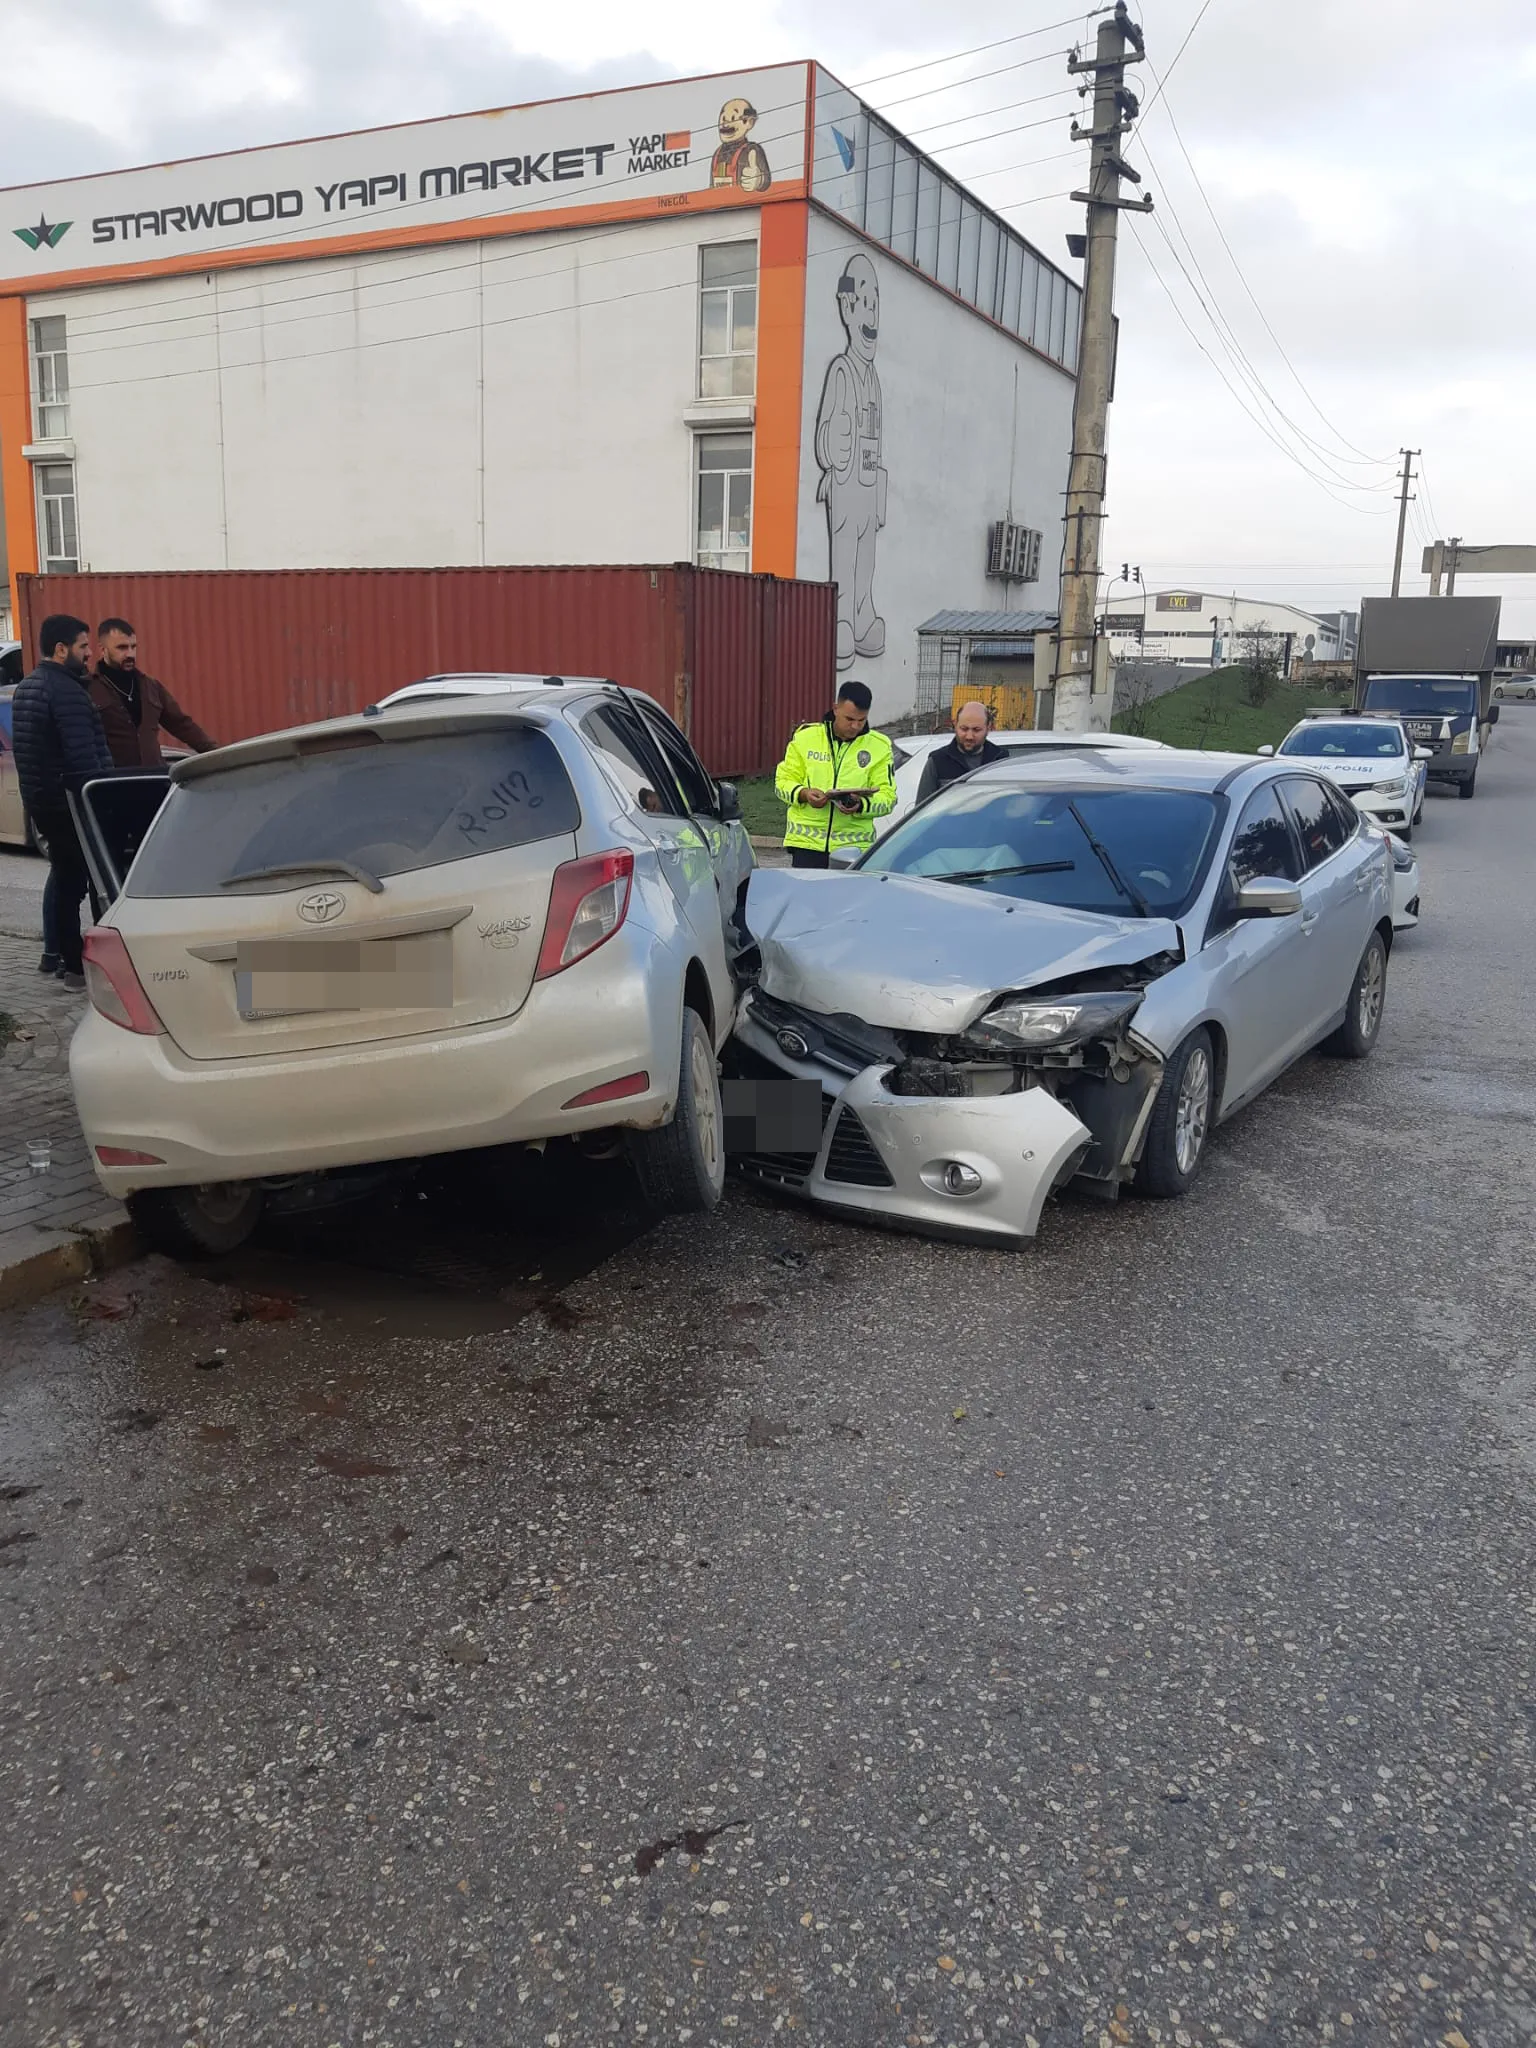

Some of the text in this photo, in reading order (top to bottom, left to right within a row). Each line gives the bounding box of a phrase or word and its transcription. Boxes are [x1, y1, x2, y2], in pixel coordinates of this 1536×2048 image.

[628, 132, 666, 155] YAPI
[627, 150, 690, 174] MARKET
[92, 143, 615, 243] STARWOOD YAPI MARKET
